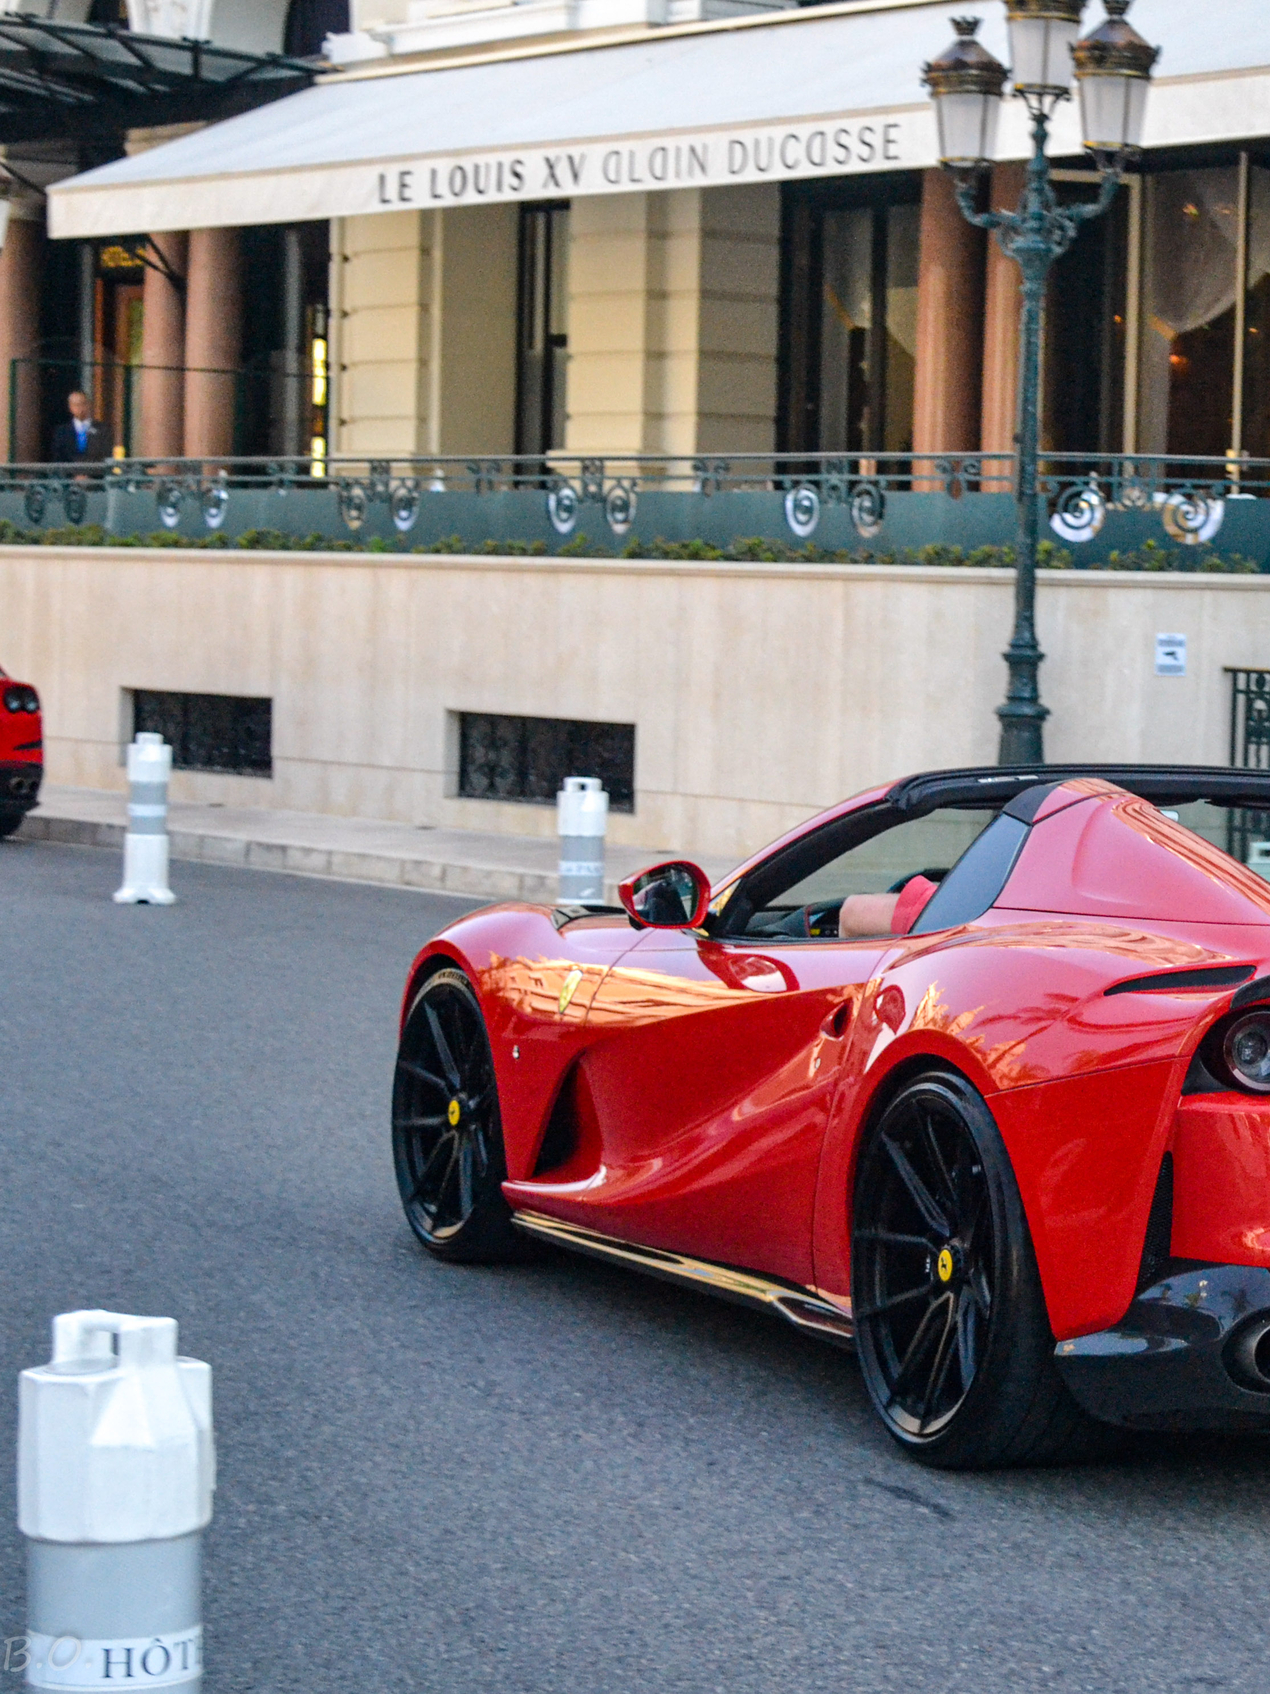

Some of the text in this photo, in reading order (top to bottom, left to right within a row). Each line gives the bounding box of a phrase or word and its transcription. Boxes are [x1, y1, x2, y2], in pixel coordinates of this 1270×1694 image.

[378, 170, 414, 204] LE
[430, 159, 527, 198] LOUIS
[541, 151, 586, 189] XV
